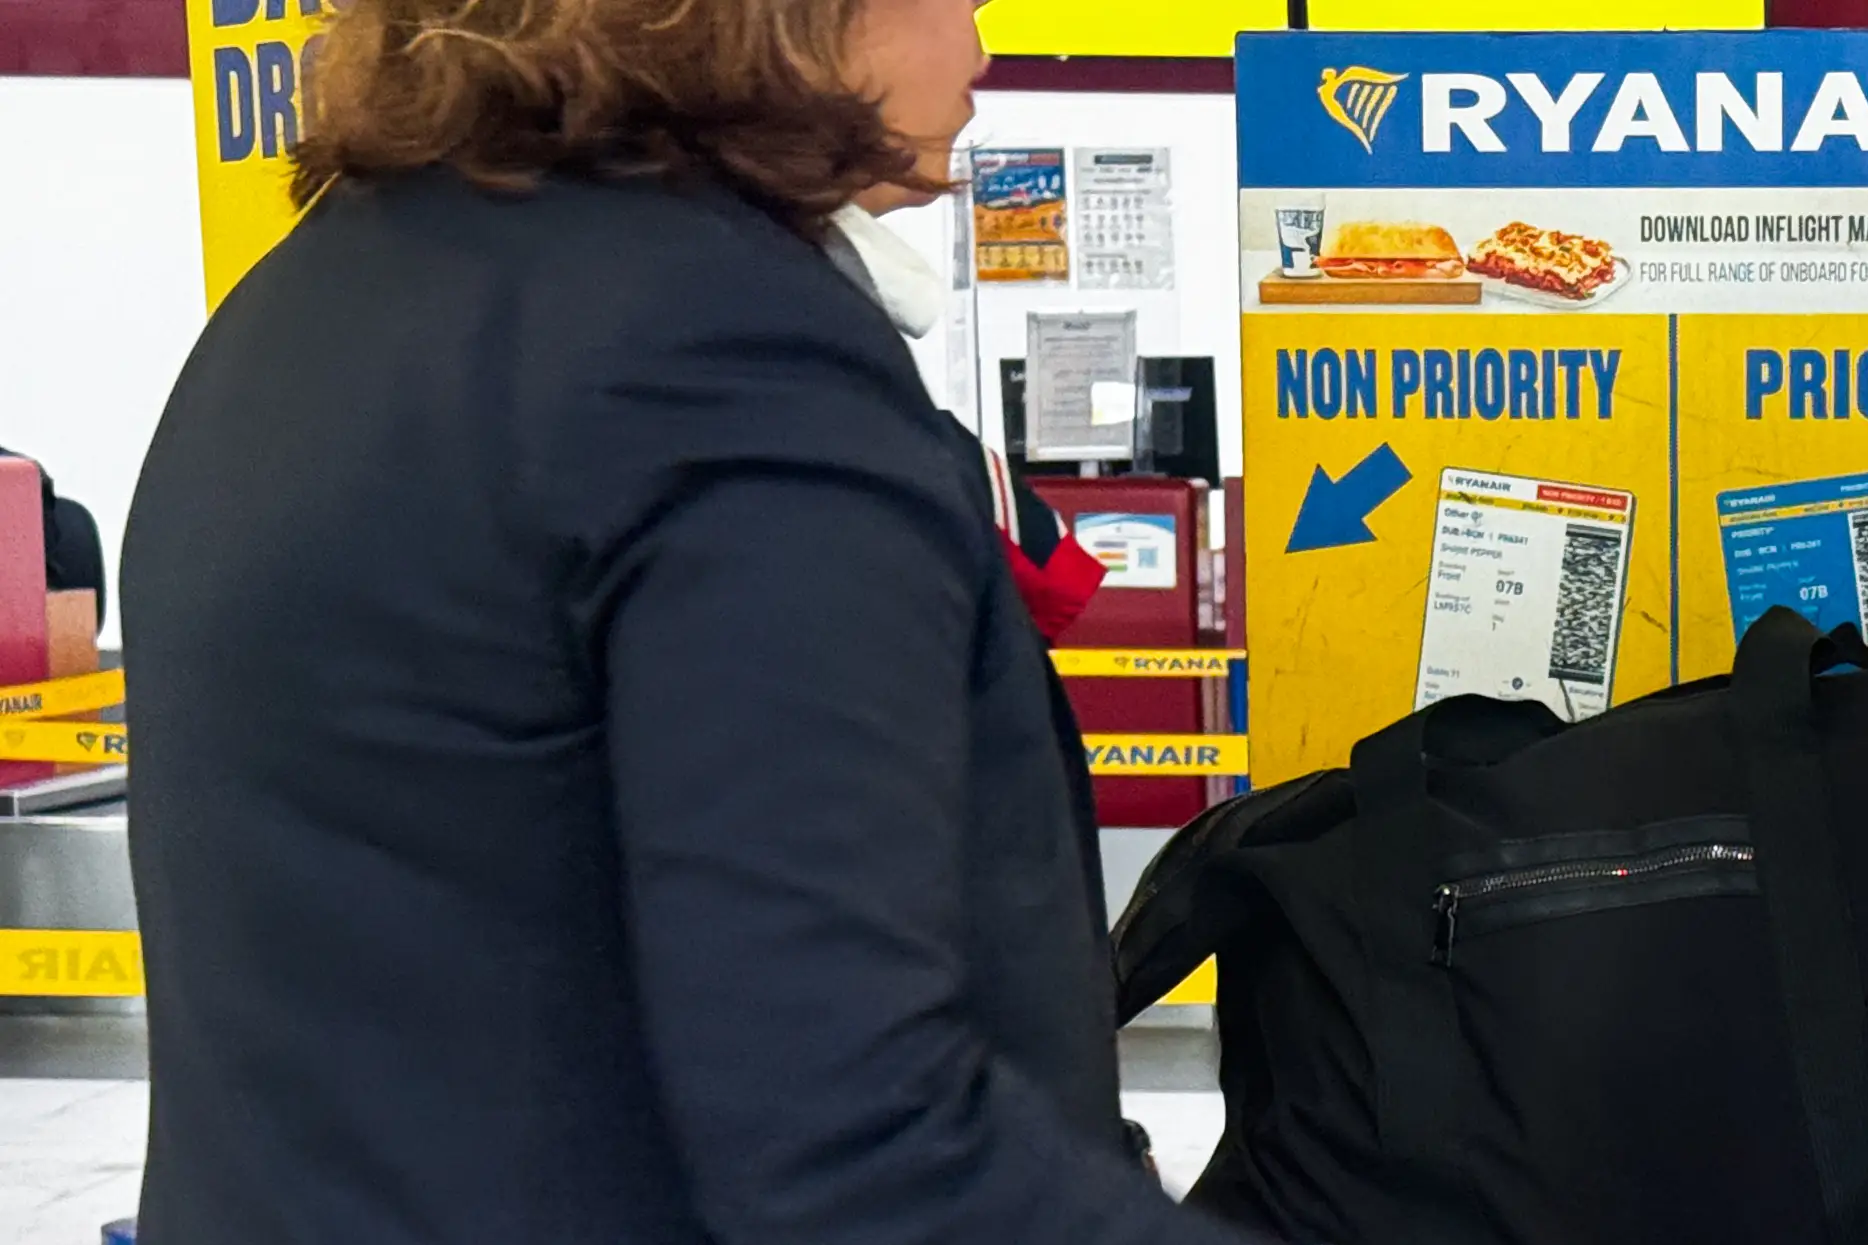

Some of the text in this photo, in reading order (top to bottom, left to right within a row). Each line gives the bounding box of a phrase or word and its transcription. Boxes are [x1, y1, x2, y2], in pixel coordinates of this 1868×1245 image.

[1640, 215, 1749, 242] DOWNLOAD
[1756, 214, 1843, 242] INFLIGHT
[1640, 262, 1666, 282] FOR
[1671, 262, 1702, 282] FULL
[1709, 262, 1755, 282] RANGE
[1759, 262, 1775, 281] OF
[1781, 262, 1846, 282] ONBOARD
[1277, 349, 1622, 420] NON PRIORITY
[1496, 579, 1524, 595] 07B
[1800, 585, 1828, 600] 07B
[1134, 657, 1223, 670] RYANA
